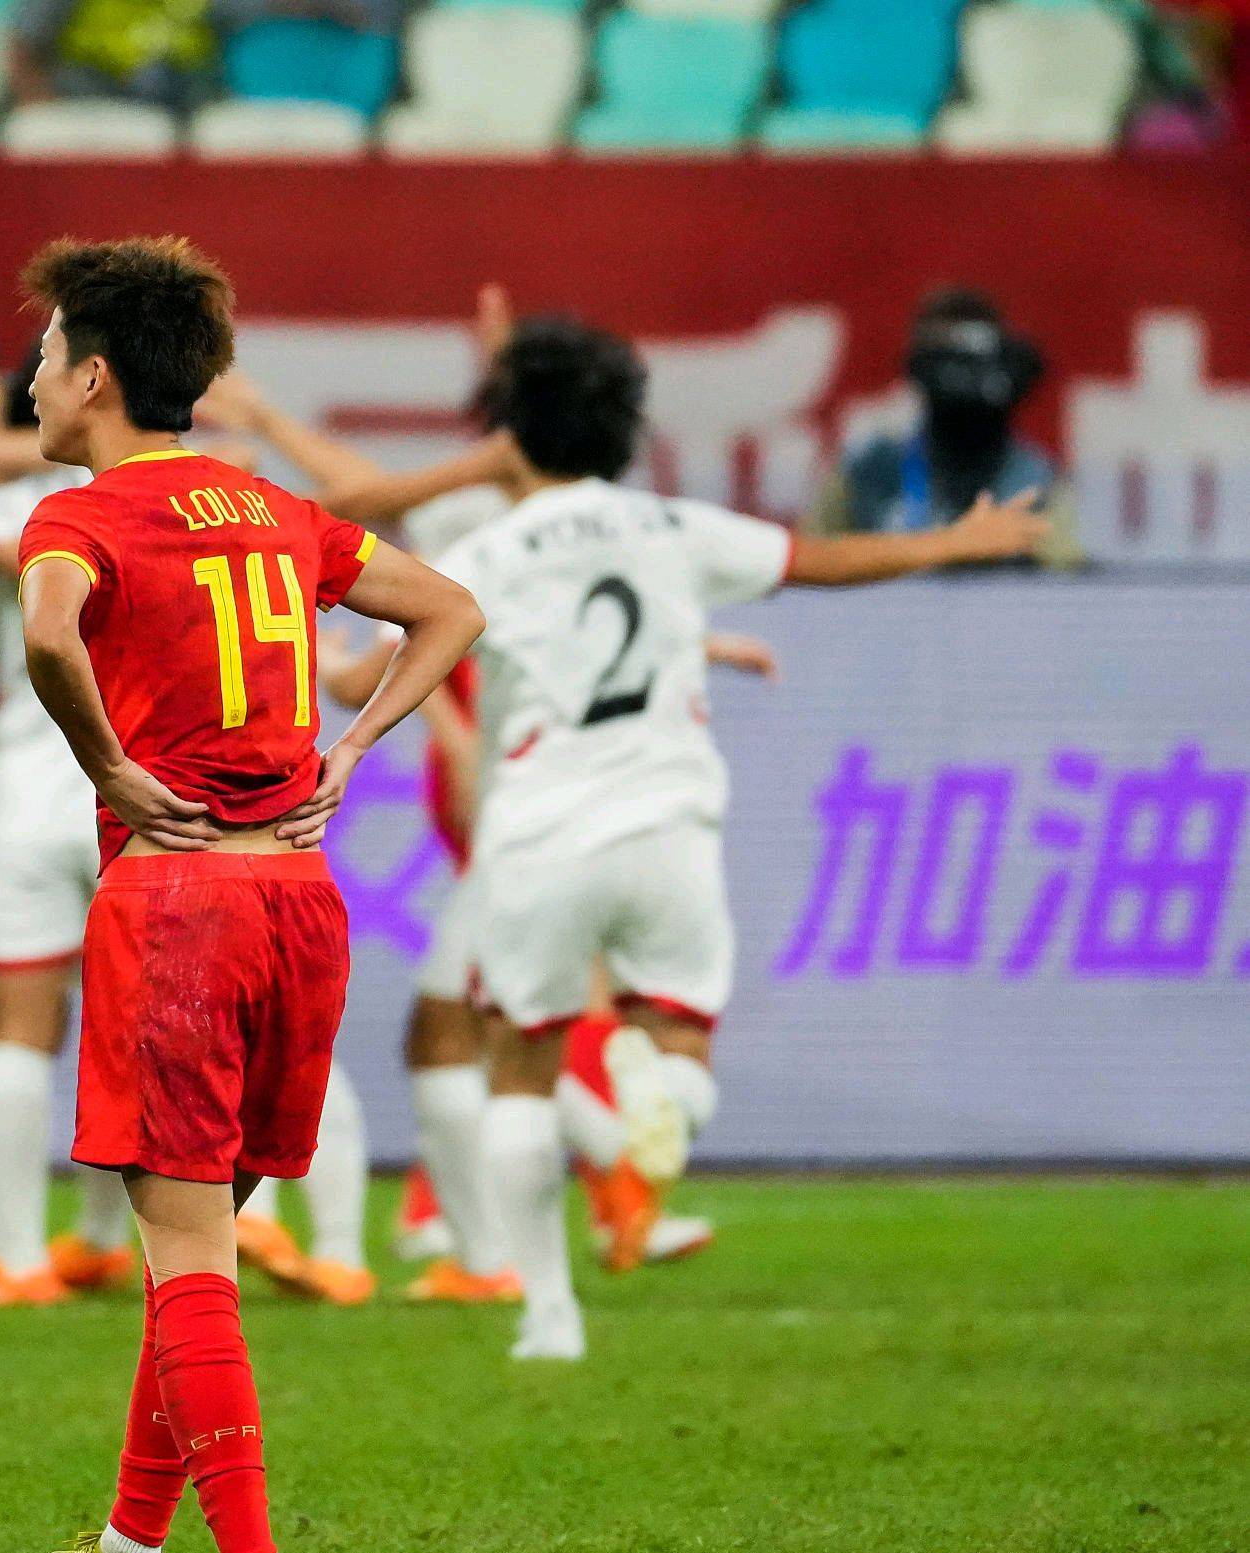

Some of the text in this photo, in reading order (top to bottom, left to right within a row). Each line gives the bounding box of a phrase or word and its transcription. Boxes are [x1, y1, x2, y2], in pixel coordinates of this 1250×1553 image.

[168, 486, 241, 531] LOU
[192, 552, 311, 729] 14
[575, 573, 657, 730] 2
[190, 1425, 257, 1450] CFA
